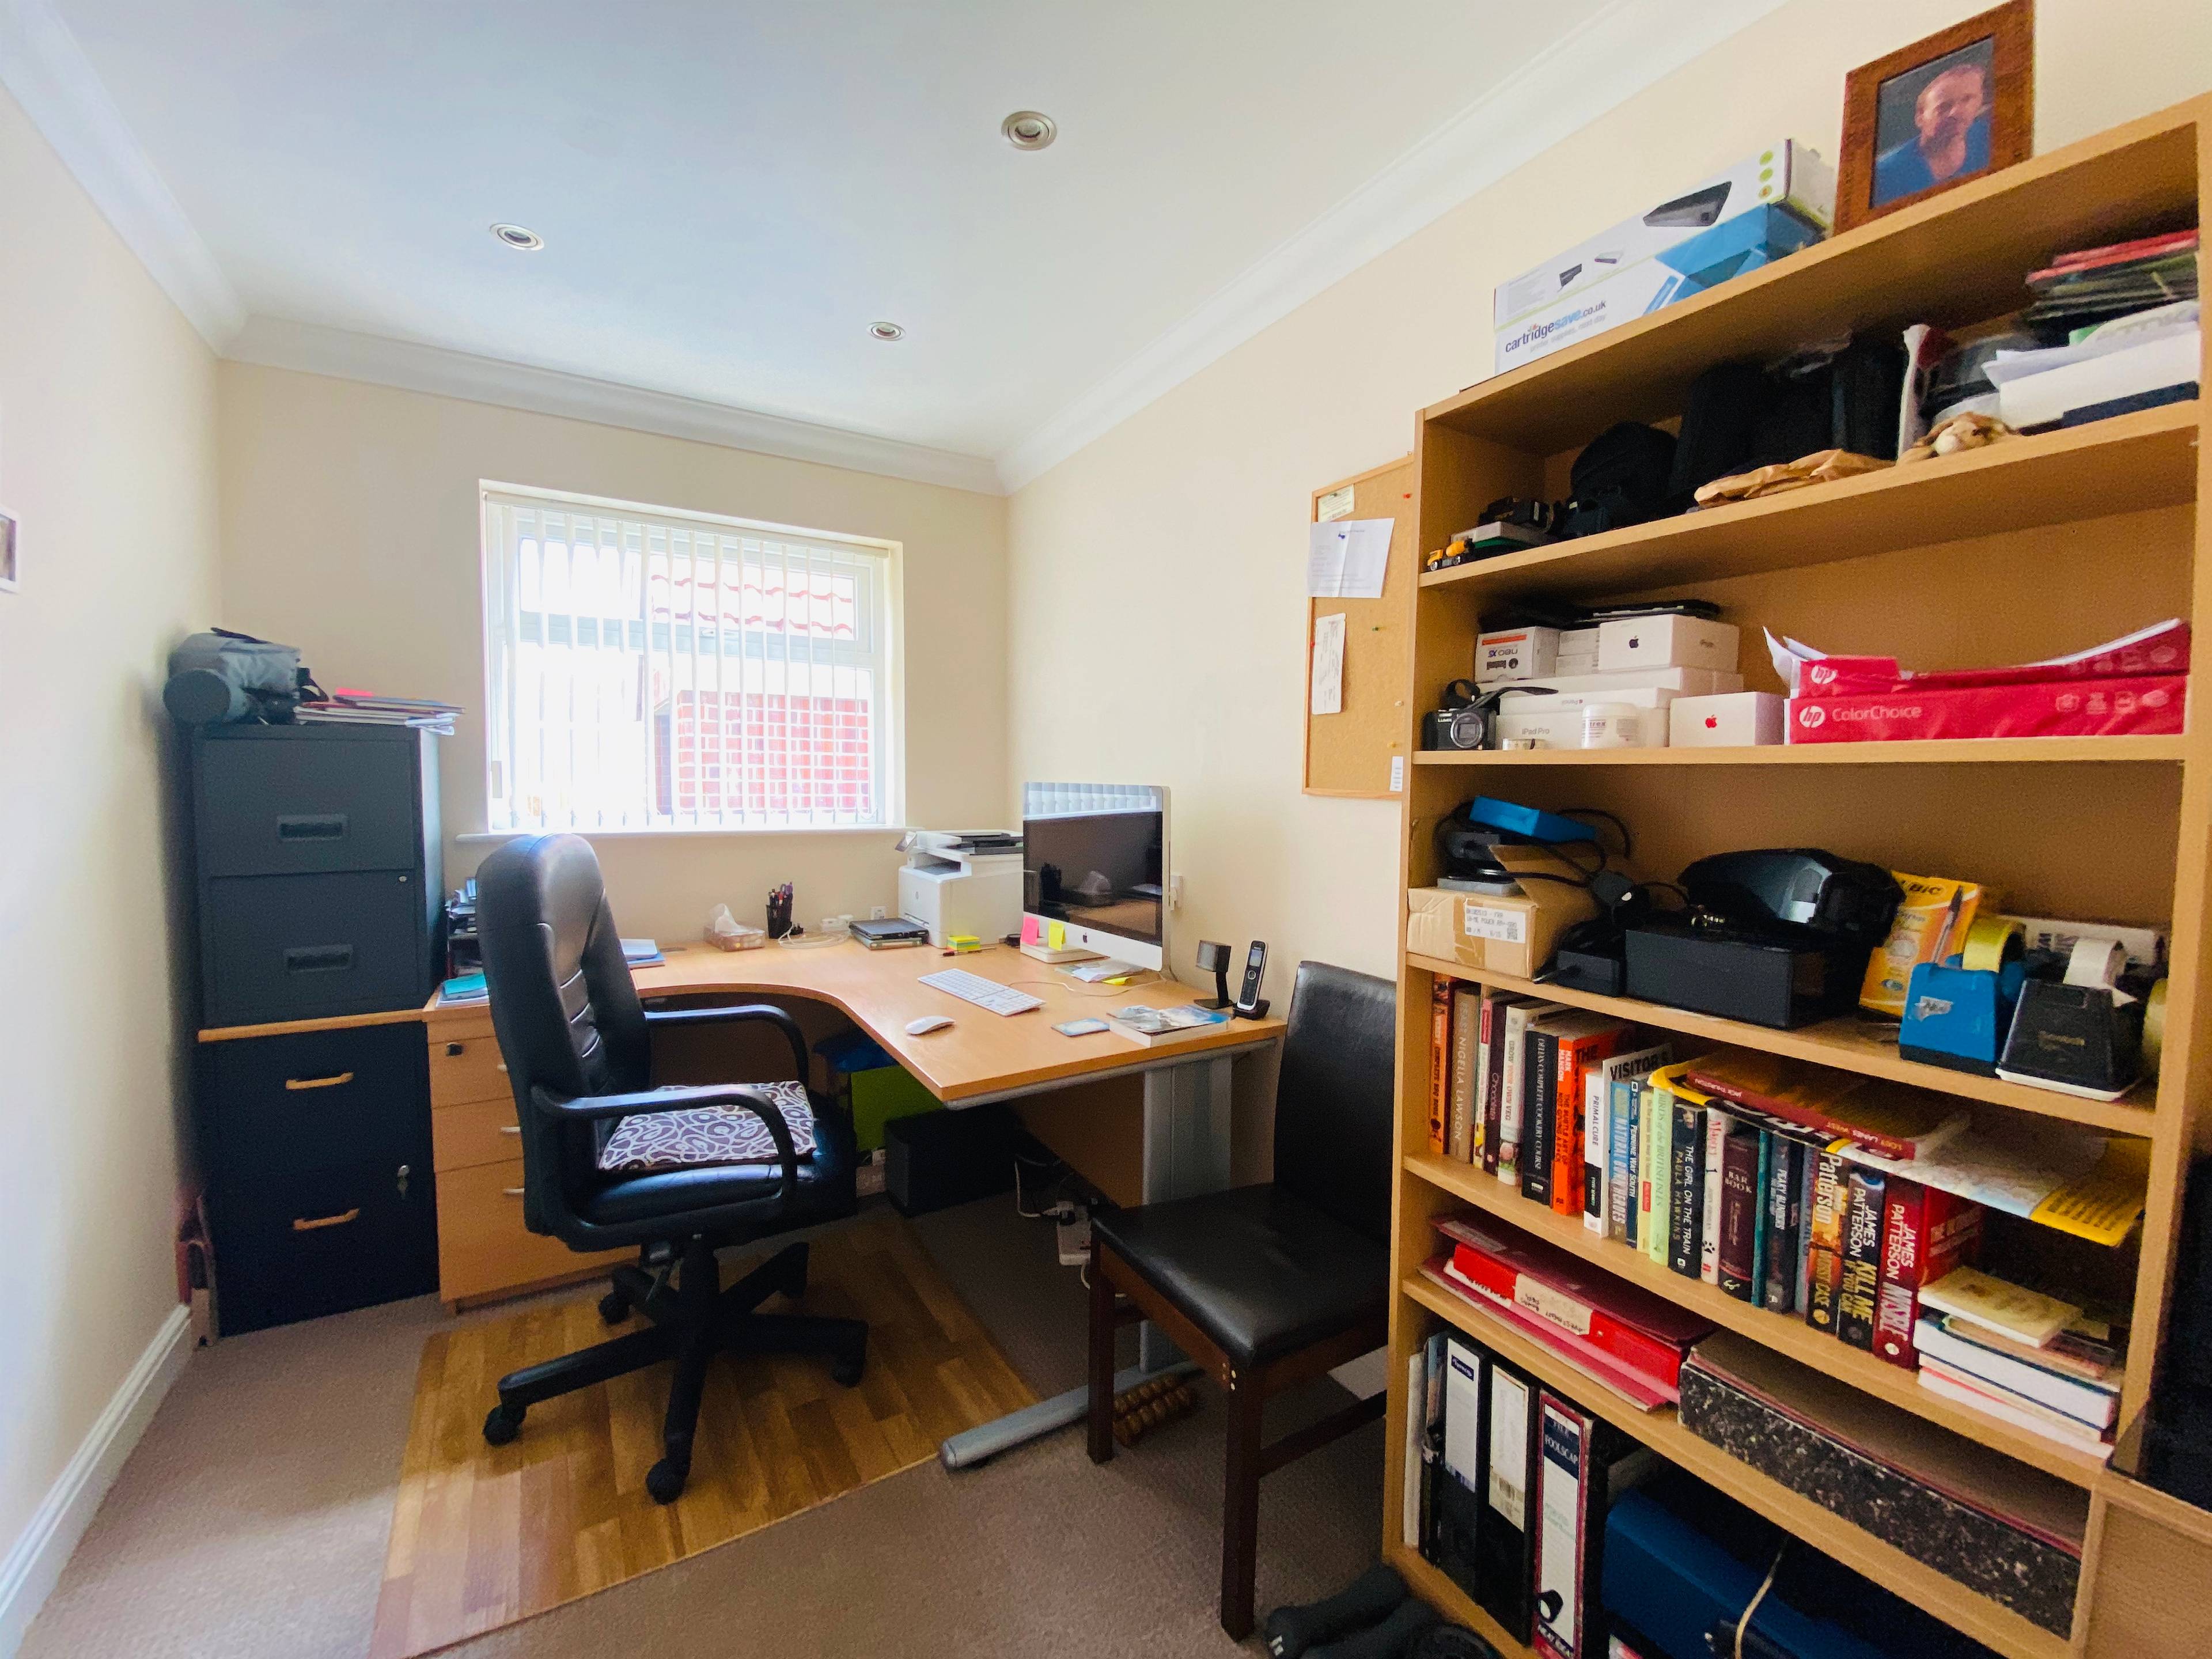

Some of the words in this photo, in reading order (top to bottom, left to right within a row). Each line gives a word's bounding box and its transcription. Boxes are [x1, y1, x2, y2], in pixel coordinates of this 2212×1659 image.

[1505, 300, 1607, 353] cartridgesave.co.uk
[1799, 706, 1825, 729] hp
[1832, 706, 1923, 721] ColorChoice
[1537, 727, 1550, 735] Pro
[1456, 1037, 1466, 1084] NIGELLA
[1564, 1050, 1572, 1071] MARK
[1575, 1044, 1599, 1062] THE
[1455, 1089, 1464, 1139] LAWSON
[1535, 1103, 1543, 1139] COOKERY
[1658, 1093, 1666, 1120] BIRDS
[1613, 1116, 1628, 1157] NATURAL
[1630, 1124, 1638, 1157] PENNINE
[1656, 1145, 1664, 1181] BRITISH
[1675, 1150, 1683, 1185] PAULA
[1684, 1145, 1694, 1162] THE
[1613, 1160, 1628, 1185] BORN
[1684, 1166, 1693, 1187] GIRL
[1725, 1178, 1752, 1194] BOOK
[1777, 1169, 1787, 1194] PEAKY
[1655, 1182, 1663, 1207] ISLES
[1683, 1190, 1692, 1204] ON
[1815, 1152, 1843, 1225] Patterson
[1612, 1185, 1627, 1224] HEROES
[1672, 1191, 1681, 1241] HAWKINS
[1683, 1207, 1692, 1224] THE
[1775, 1194, 1786, 1230] BLINDERS
[1850, 1187, 1866, 1258] PATTERSON
[1862, 1206, 1877, 1248] JAMES
[1682, 1228, 1692, 1255] TRAIN
[1886, 1203, 1905, 1281] PATTERSON
[1900, 1222, 1917, 1269] JAMES
[1842, 1272, 1855, 1293] YOU
[1854, 1260, 1877, 1295] KILL
[1815, 1282, 1831, 1308] CASE
[1853, 1294, 1875, 1325] ME
[1544, 1434, 1578, 1464] FOOLSCAP
